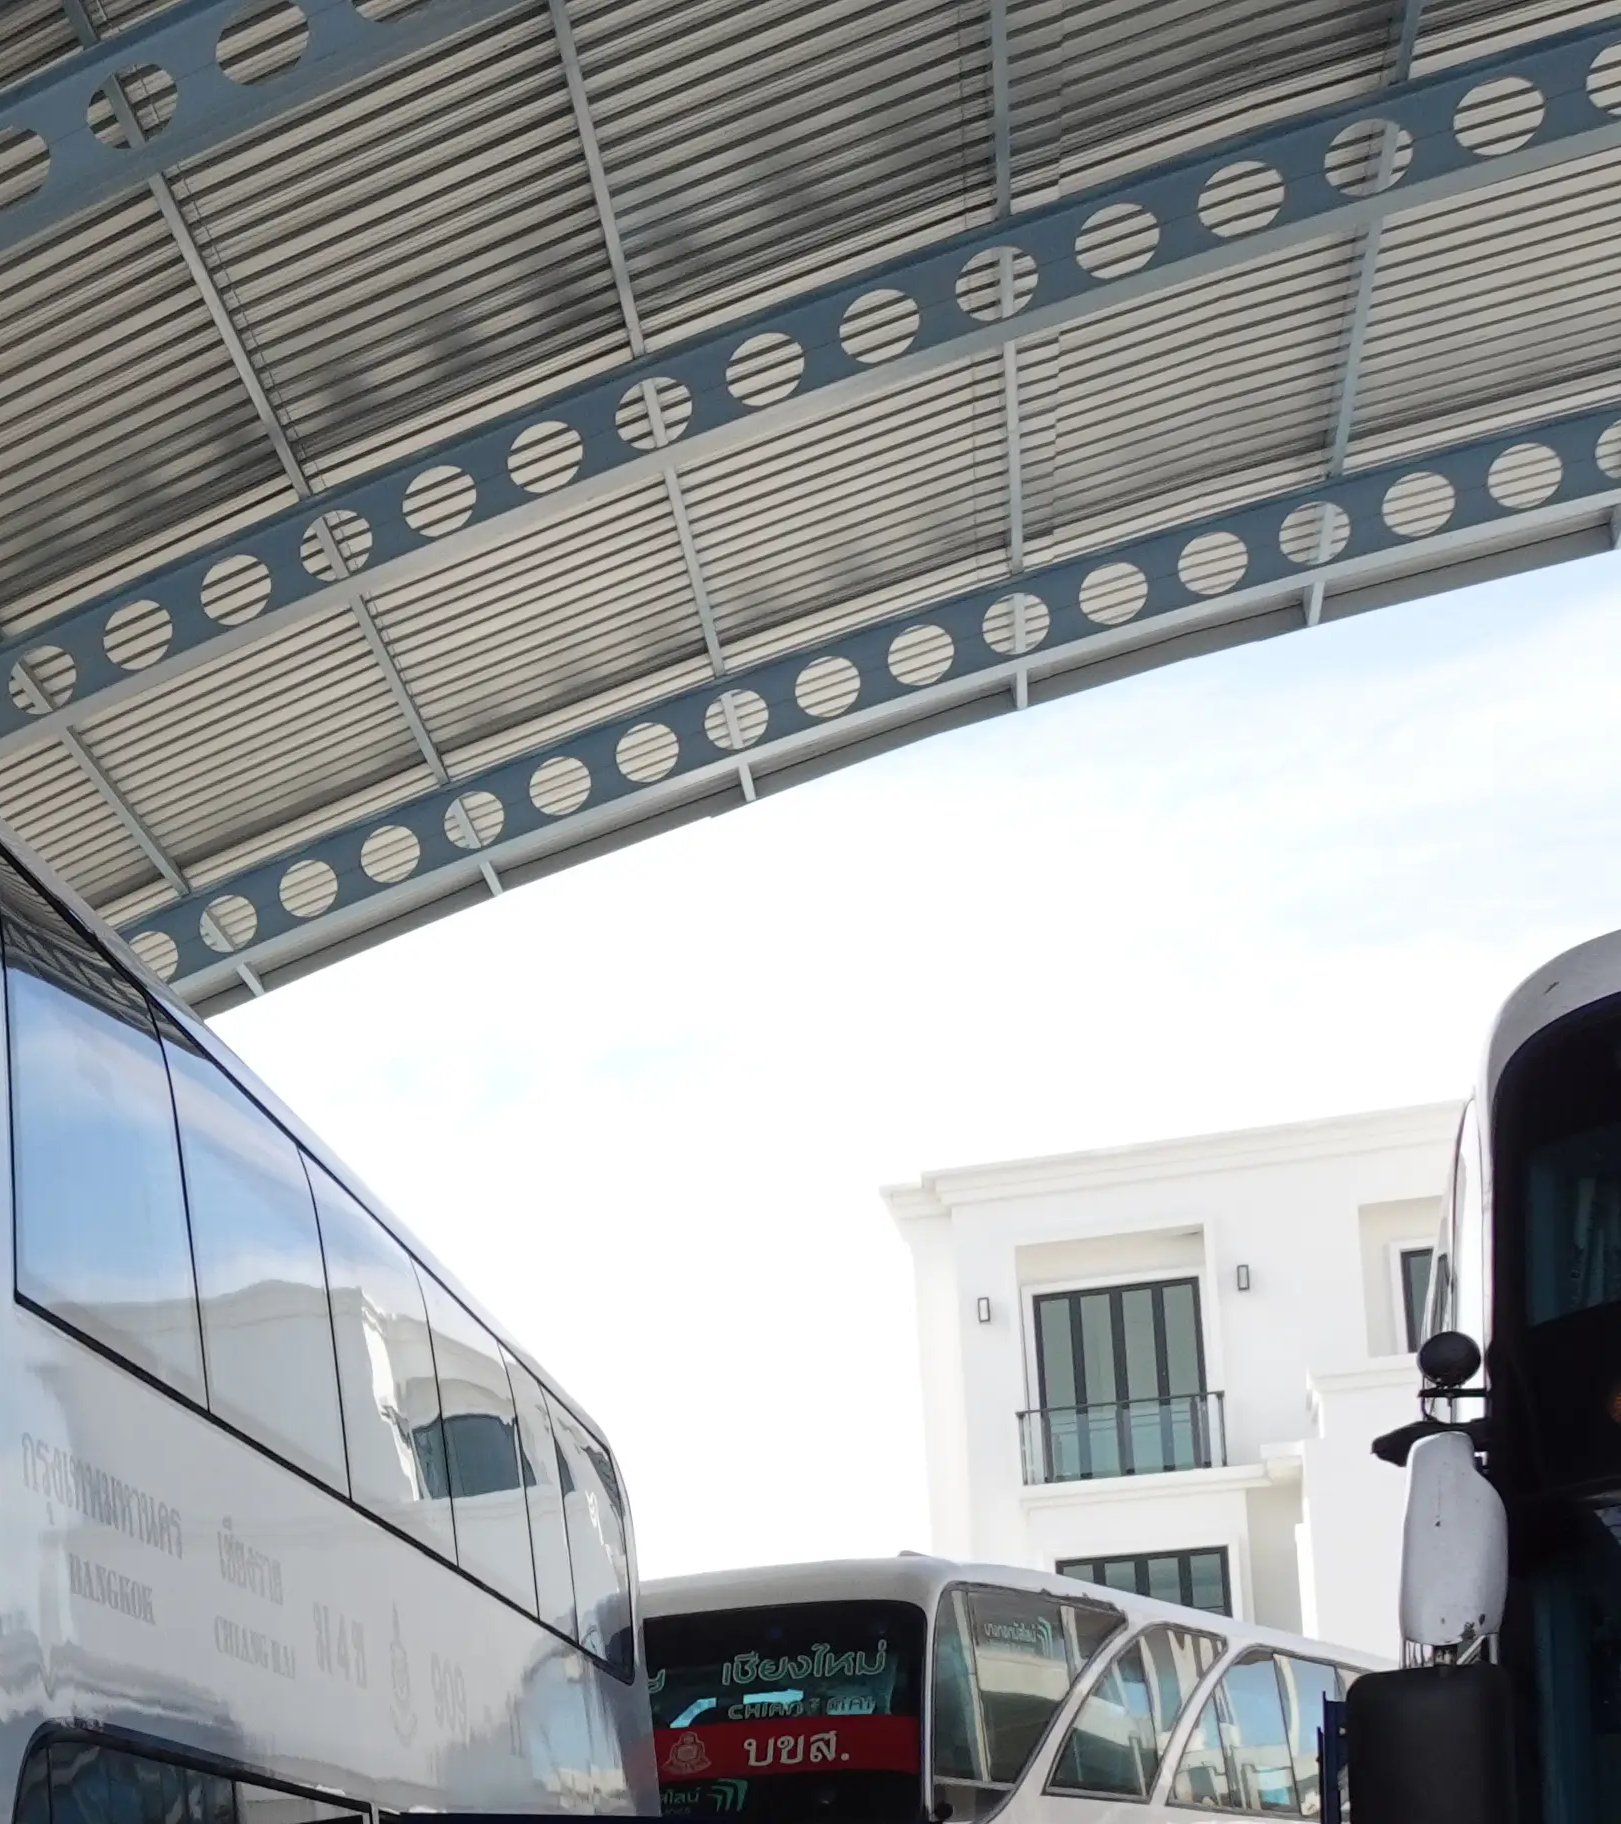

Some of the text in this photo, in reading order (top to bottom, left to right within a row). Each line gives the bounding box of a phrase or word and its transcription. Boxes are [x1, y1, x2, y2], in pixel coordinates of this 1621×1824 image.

[68, 1552, 156, 1625] BANGKOK
[722, 1638, 888, 1686] เชียงใหม่
[743, 1730, 851, 1767] บขส.
